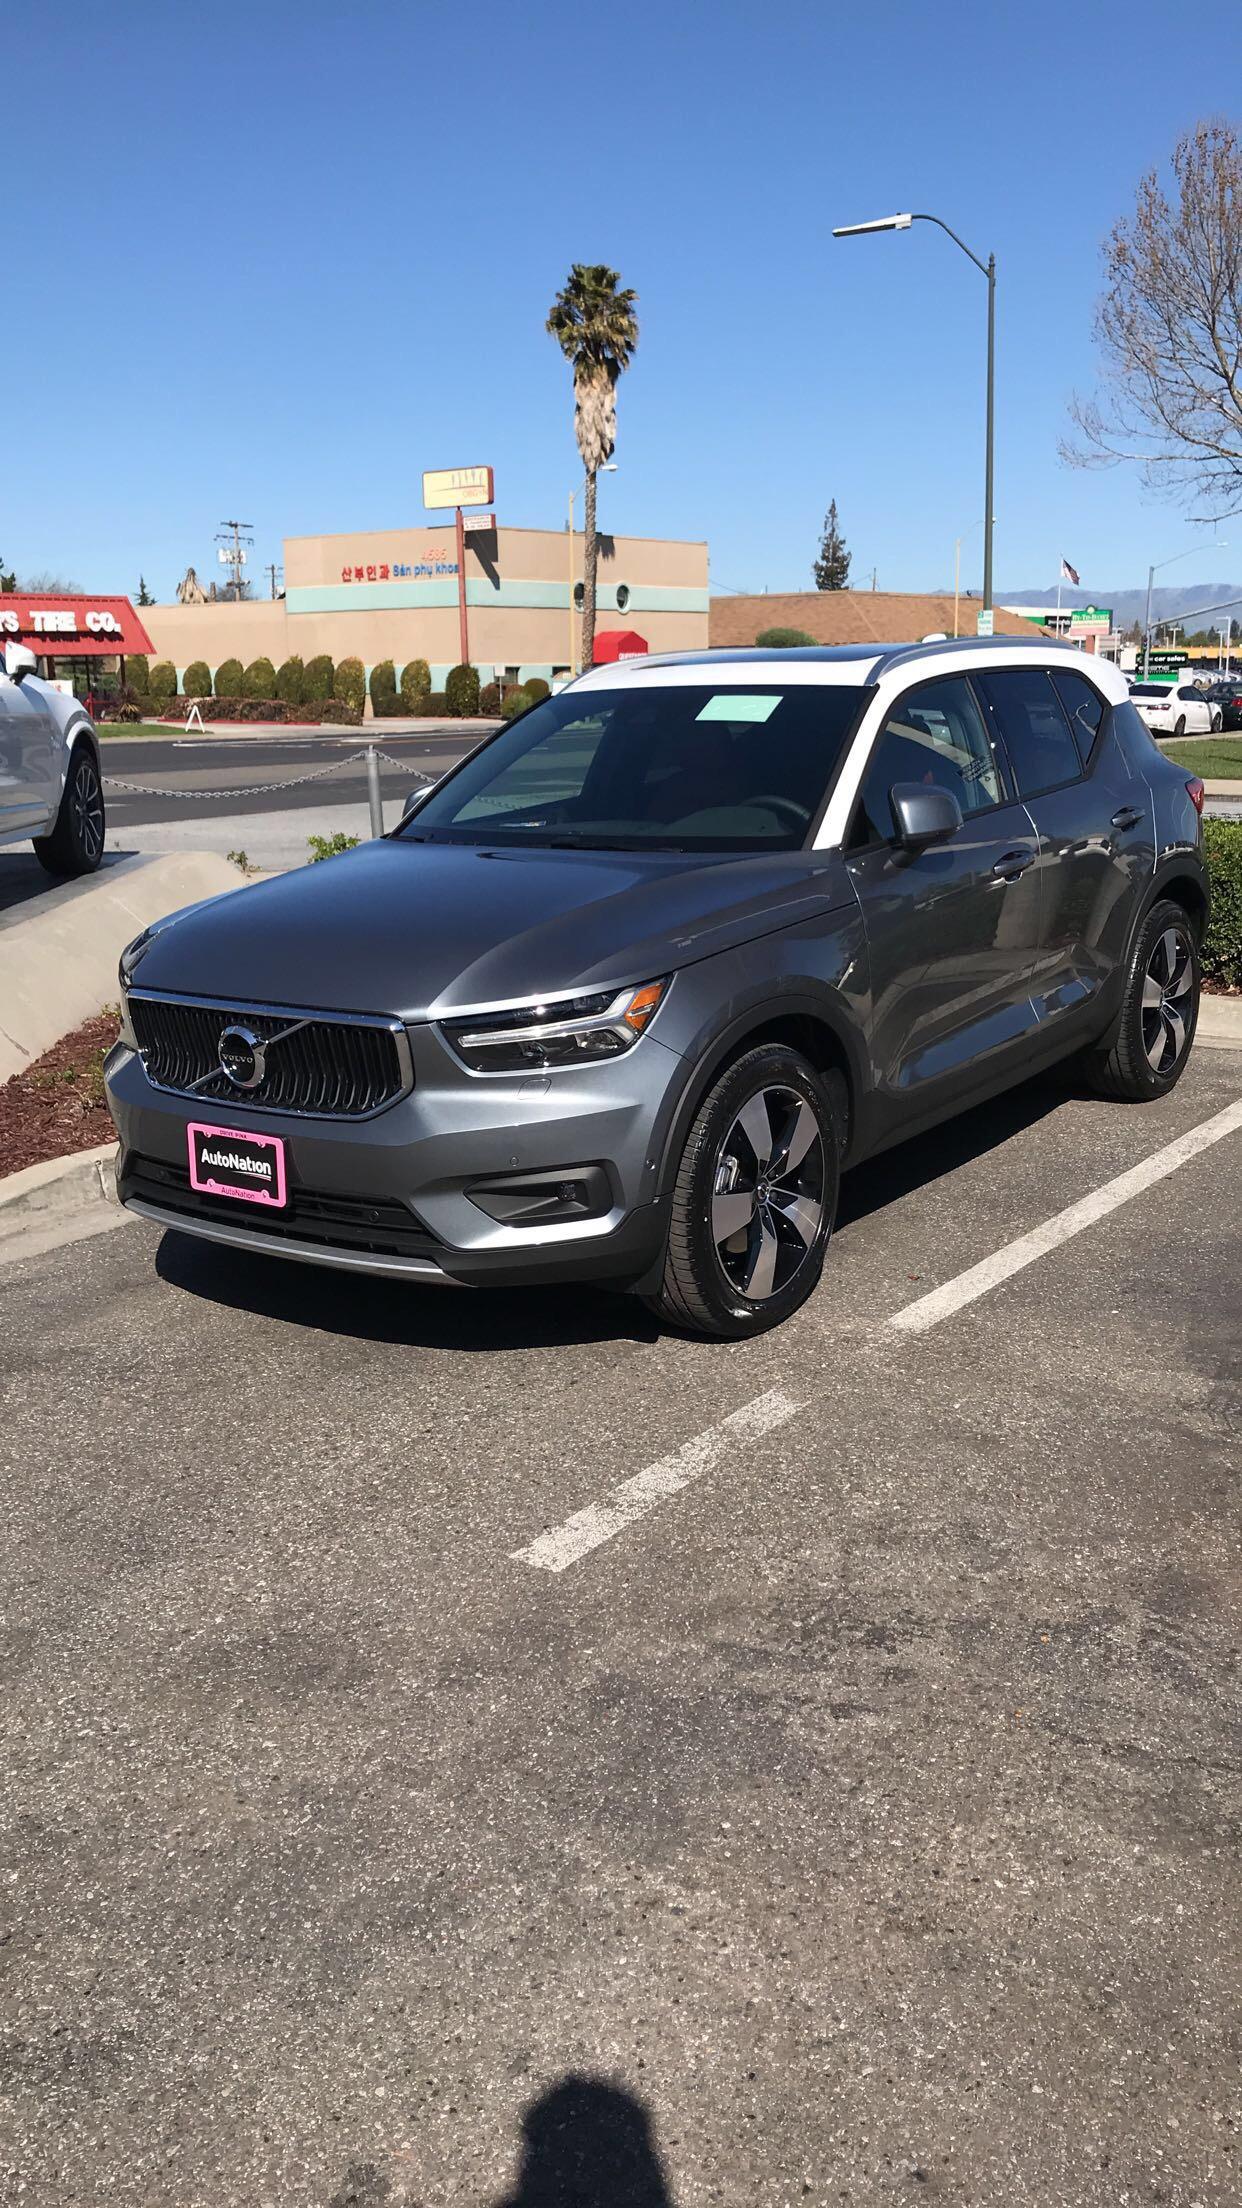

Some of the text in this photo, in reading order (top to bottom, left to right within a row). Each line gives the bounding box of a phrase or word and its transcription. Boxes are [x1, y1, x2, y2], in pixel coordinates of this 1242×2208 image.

[341, 563, 390, 583] 산부인과
[28, 610, 77, 632] TIRE
[85, 610, 122, 633] CO.
[221, 1053, 253, 1063] VOLVO
[201, 1148, 272, 1176] AutoNation
[221, 1186, 255, 1200] AutoNation
